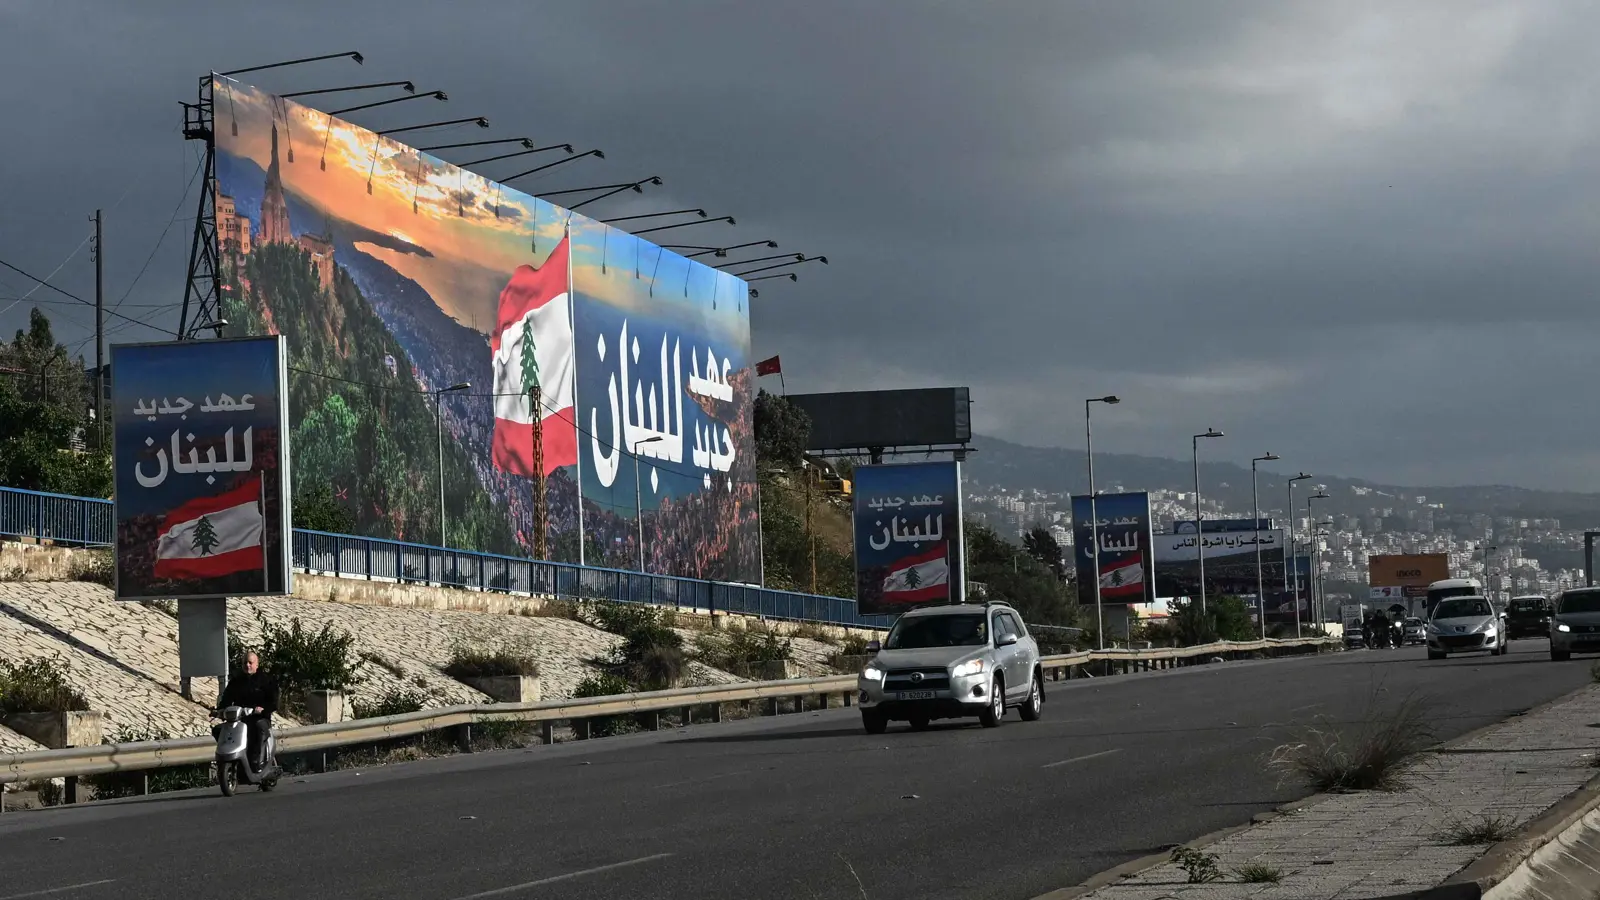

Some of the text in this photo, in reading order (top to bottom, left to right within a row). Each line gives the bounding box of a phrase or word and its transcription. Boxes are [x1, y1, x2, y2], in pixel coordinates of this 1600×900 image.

[689, 345, 733, 402] عهد
[133, 392, 256, 422] عهد جديد
[591, 318, 683, 494] للبنان
[135, 425, 253, 488] للبنان
[692, 418, 736, 493] جديد
[868, 494, 944, 512] عهد جديد
[869, 513, 943, 551] للبنان
[1112, 516, 1138, 526] عهد
[1172, 537, 1197, 551] الناس
[1225, 536, 1235, 549] يا
